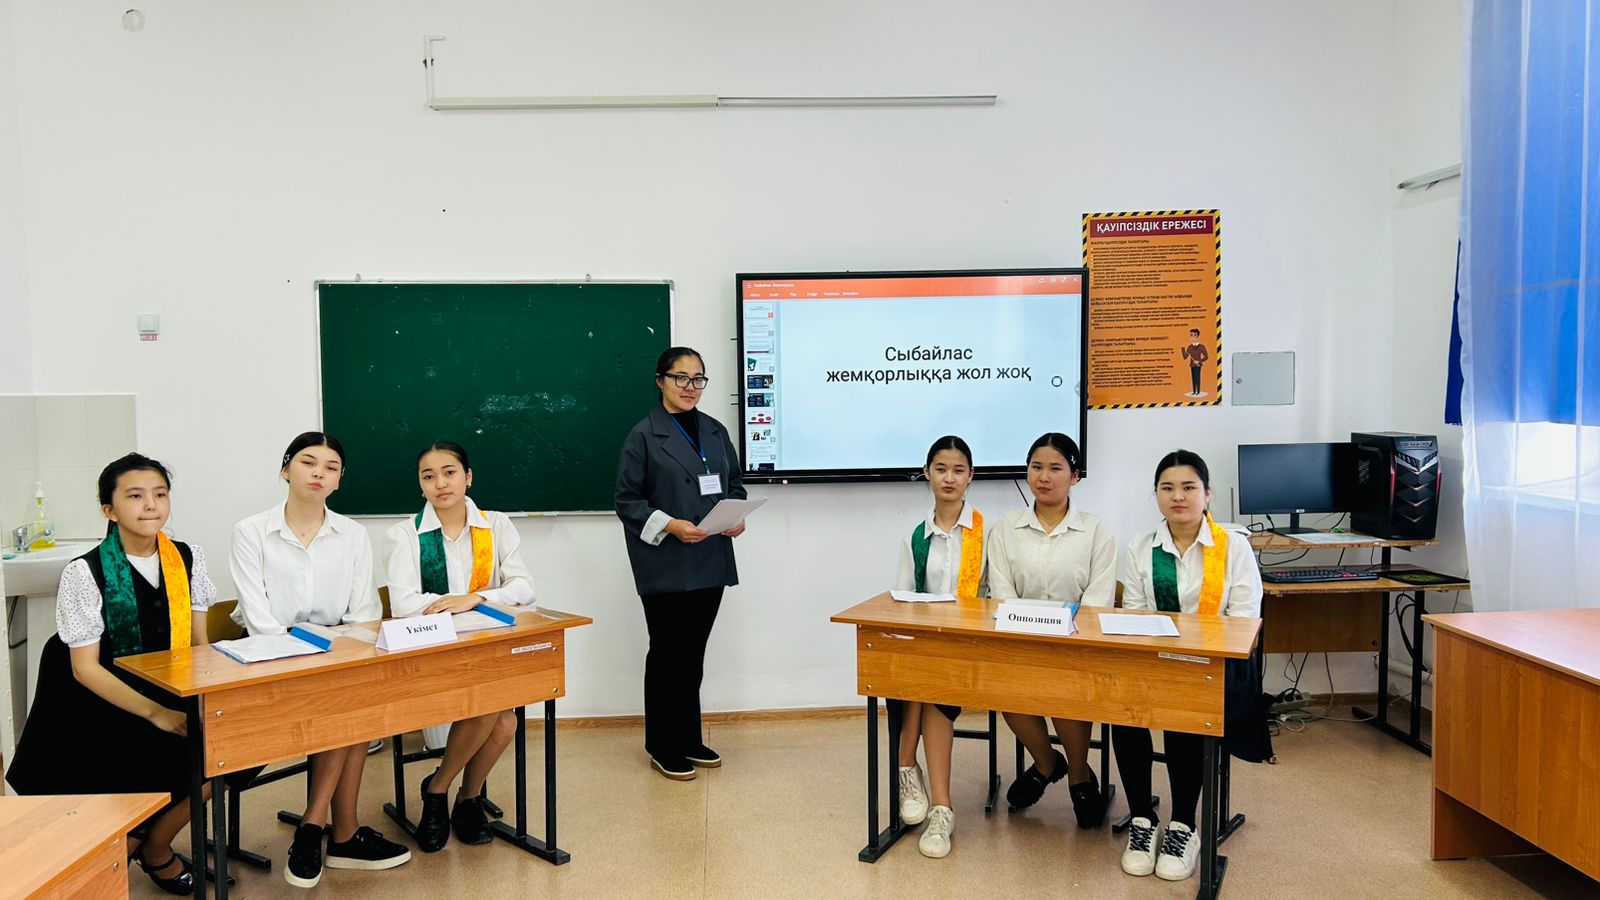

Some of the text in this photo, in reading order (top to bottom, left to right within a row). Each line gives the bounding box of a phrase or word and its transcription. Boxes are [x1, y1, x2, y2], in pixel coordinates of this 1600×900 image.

[1097, 219, 1207, 233] ҚАУІПСІЗДІК ЕРЕЖЕСІ
[885, 345, 973, 362] Сыбайлас
[826, 366, 1032, 384] жемқорлыққа жол жоқ
[1008, 613, 1062, 625] Оппозиция
[406, 624, 438, 634] Үкімет
